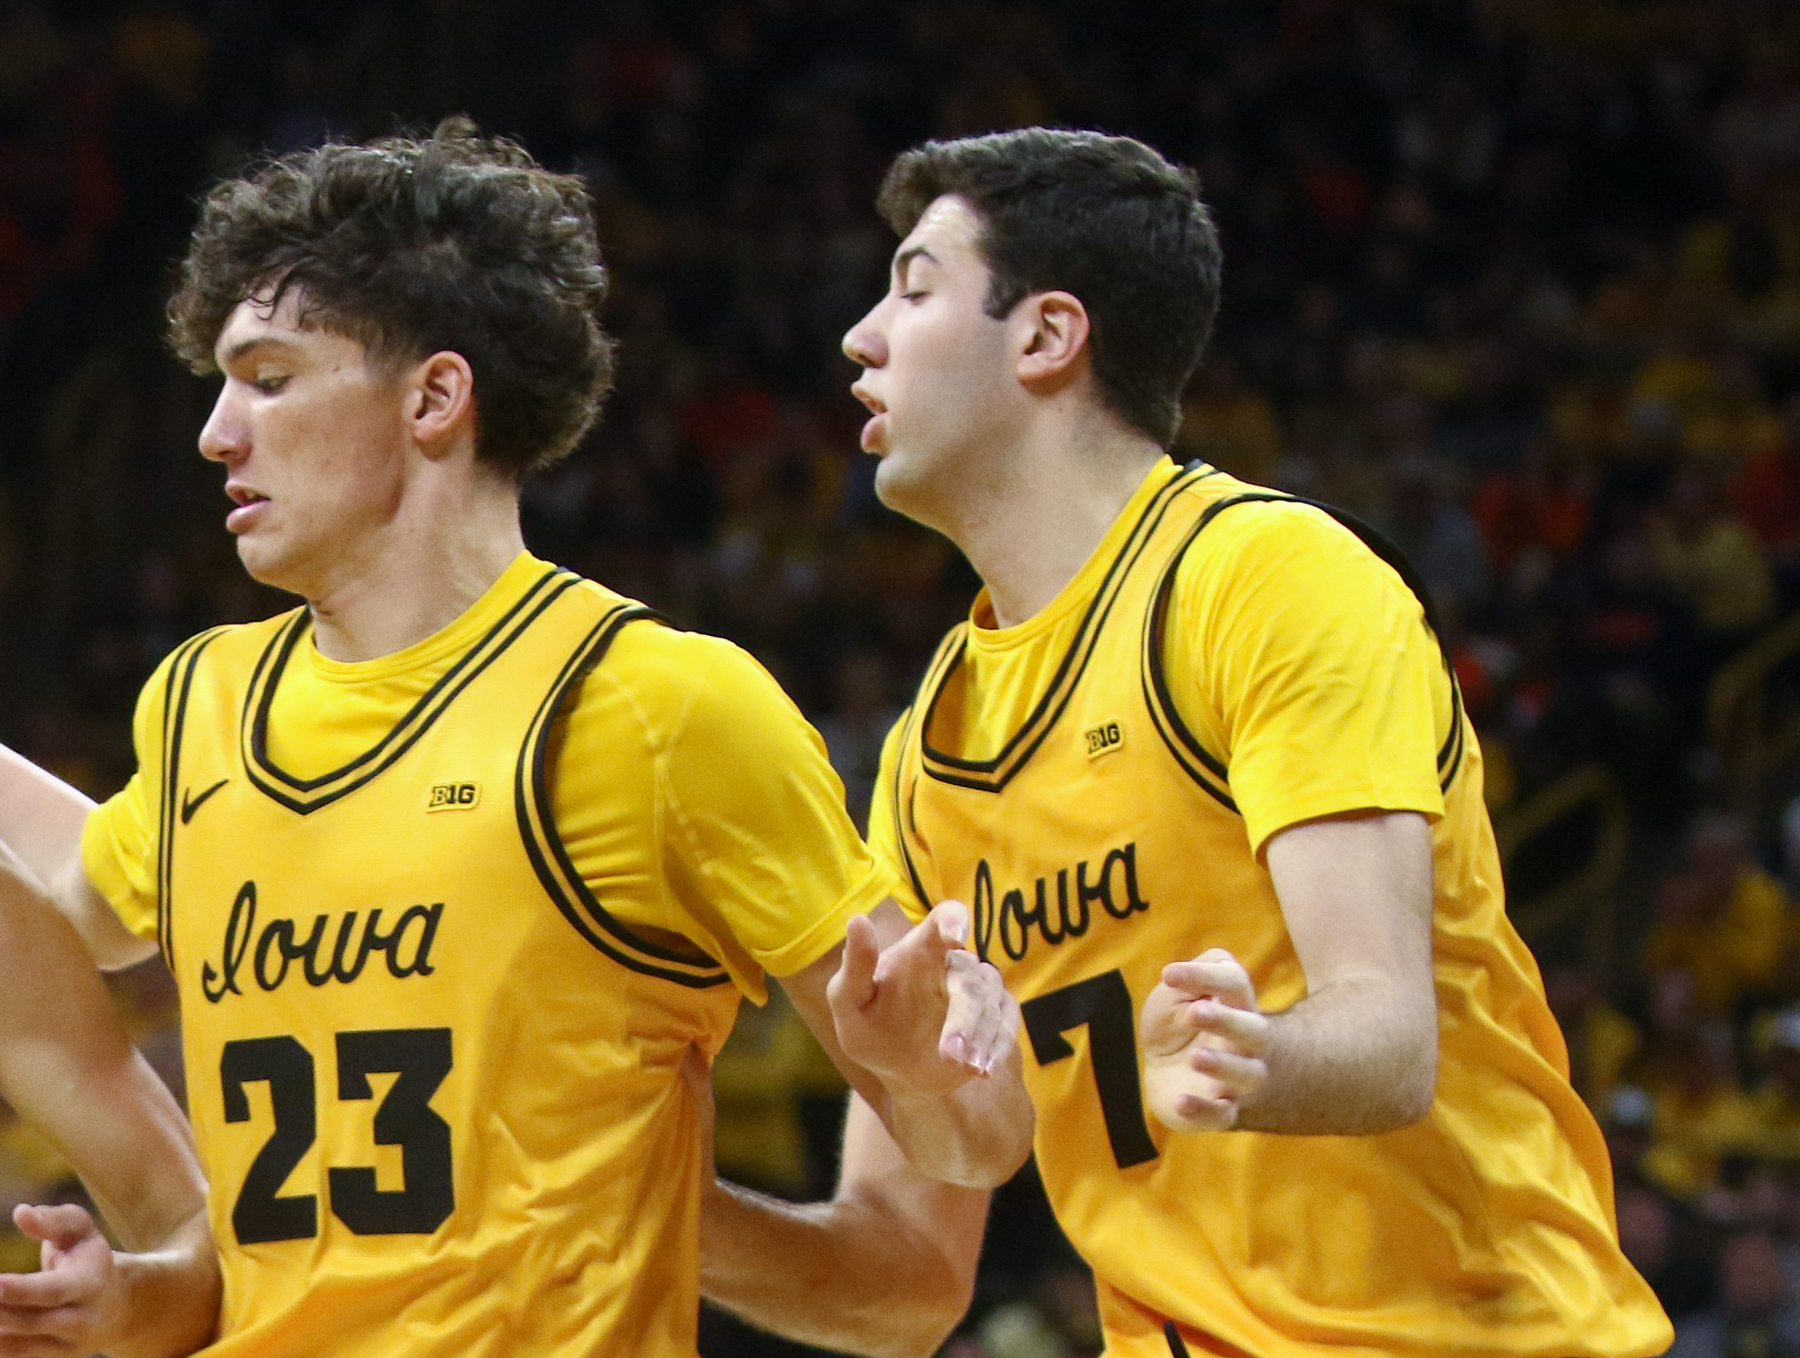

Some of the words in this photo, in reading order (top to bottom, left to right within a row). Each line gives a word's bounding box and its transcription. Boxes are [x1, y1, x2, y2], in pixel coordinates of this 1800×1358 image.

[203, 880, 444, 1003] Iowa
[974, 842, 1149, 964] Iowa
[219, 1028, 454, 1245] 23
[1021, 968, 1159, 1168] 7
